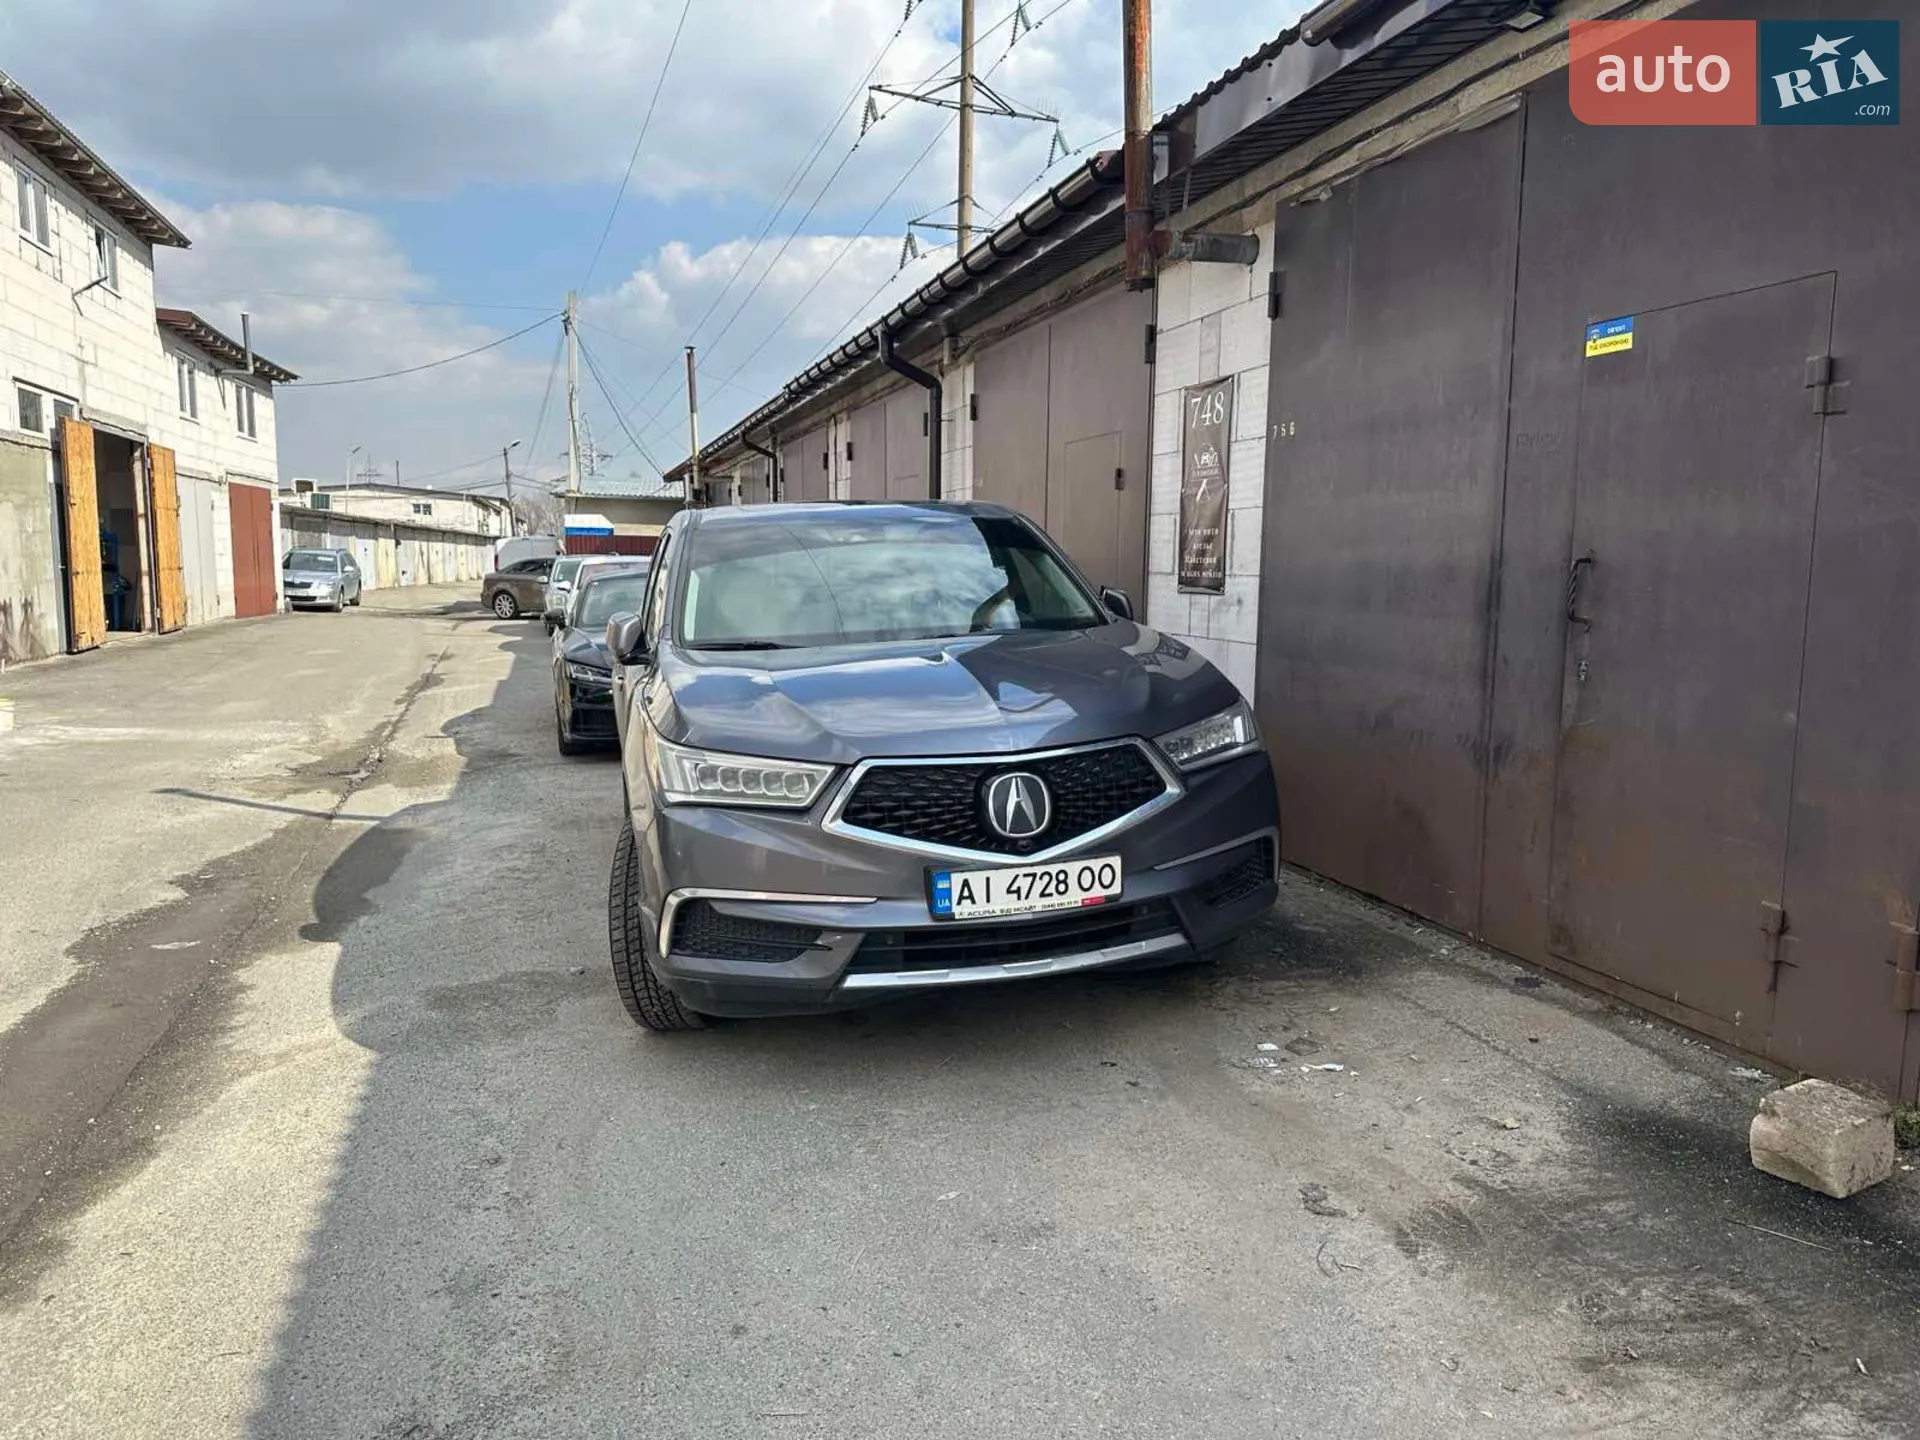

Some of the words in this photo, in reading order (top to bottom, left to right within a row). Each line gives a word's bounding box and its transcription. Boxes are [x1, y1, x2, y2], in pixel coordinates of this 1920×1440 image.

[1191, 391, 1225, 429] 748
[1273, 421, 1295, 440] 756
[937, 900, 950, 908] UA
[956, 876, 991, 906] AI
[1006, 869, 1069, 901] 4728
